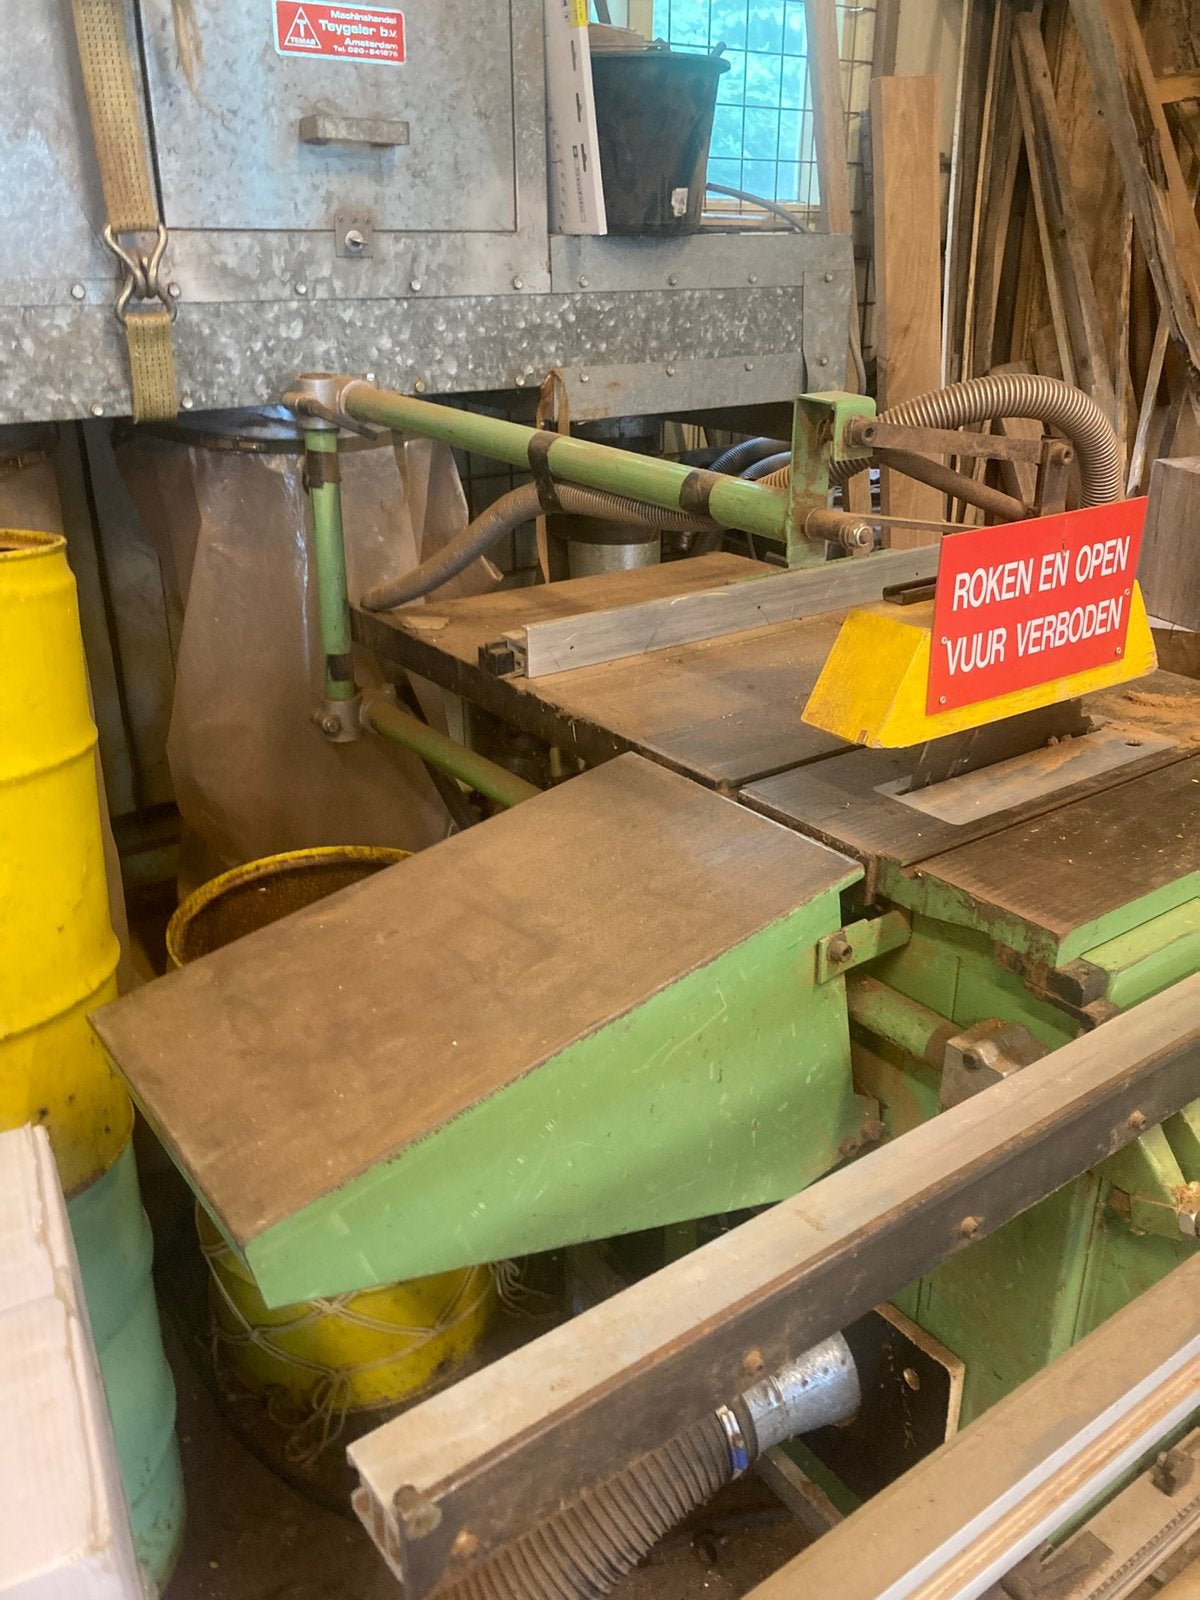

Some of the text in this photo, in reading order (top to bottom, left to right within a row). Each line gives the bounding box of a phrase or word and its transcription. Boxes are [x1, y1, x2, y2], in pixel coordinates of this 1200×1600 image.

[296, 19, 307, 37] T
[318, 19, 377, 36] Teygeler
[344, 37, 399, 50] Amsterdam
[952, 536, 1131, 612] ROKEN EN OPEN
[946, 596, 1123, 676] VUUR VERBODEN
